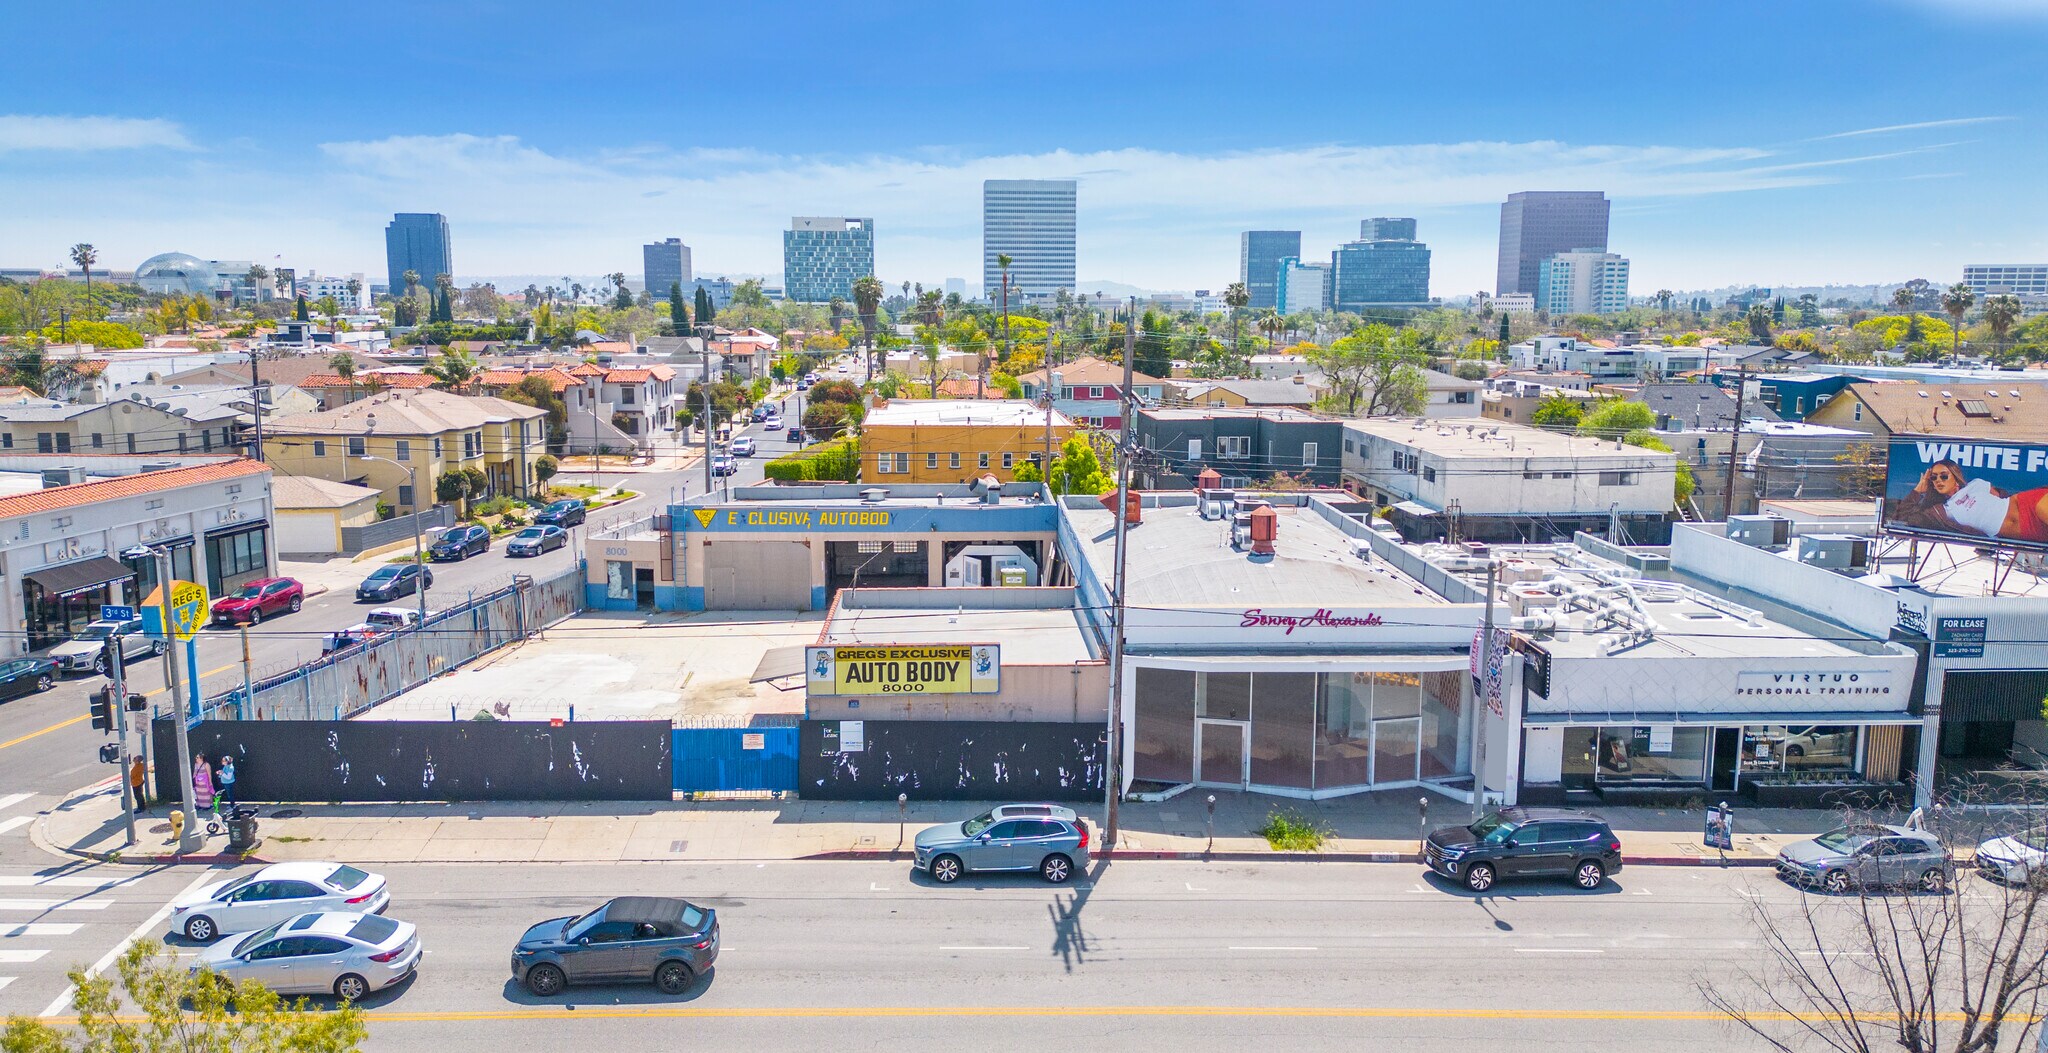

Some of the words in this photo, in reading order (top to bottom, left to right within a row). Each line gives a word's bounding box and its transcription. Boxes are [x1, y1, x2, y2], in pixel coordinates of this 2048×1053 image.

[1916, 441, 2021, 471] WHITE
[2026, 449, 2048, 473] F
[605, 547, 628, 556] 8000
[172, 588, 202, 608] REG'S
[105, 608, 118, 618] 3rd
[120, 609, 130, 617] St
[191, 613, 201, 631] AUTO
[1240, 608, 1297, 635] Sonny
[1299, 608, 1383, 628] Alexander
[1943, 619, 1959, 627] FOR
[1960, 619, 1985, 627] LEASE
[836, 649, 887, 659] GREG'S
[890, 648, 970, 659] EXCLUSIVE
[845, 661, 900, 684] AUTO
[906, 661, 960, 683] BODY
[1773, 673, 1859, 683] VIRTUO
[882, 683, 925, 692] 8000
